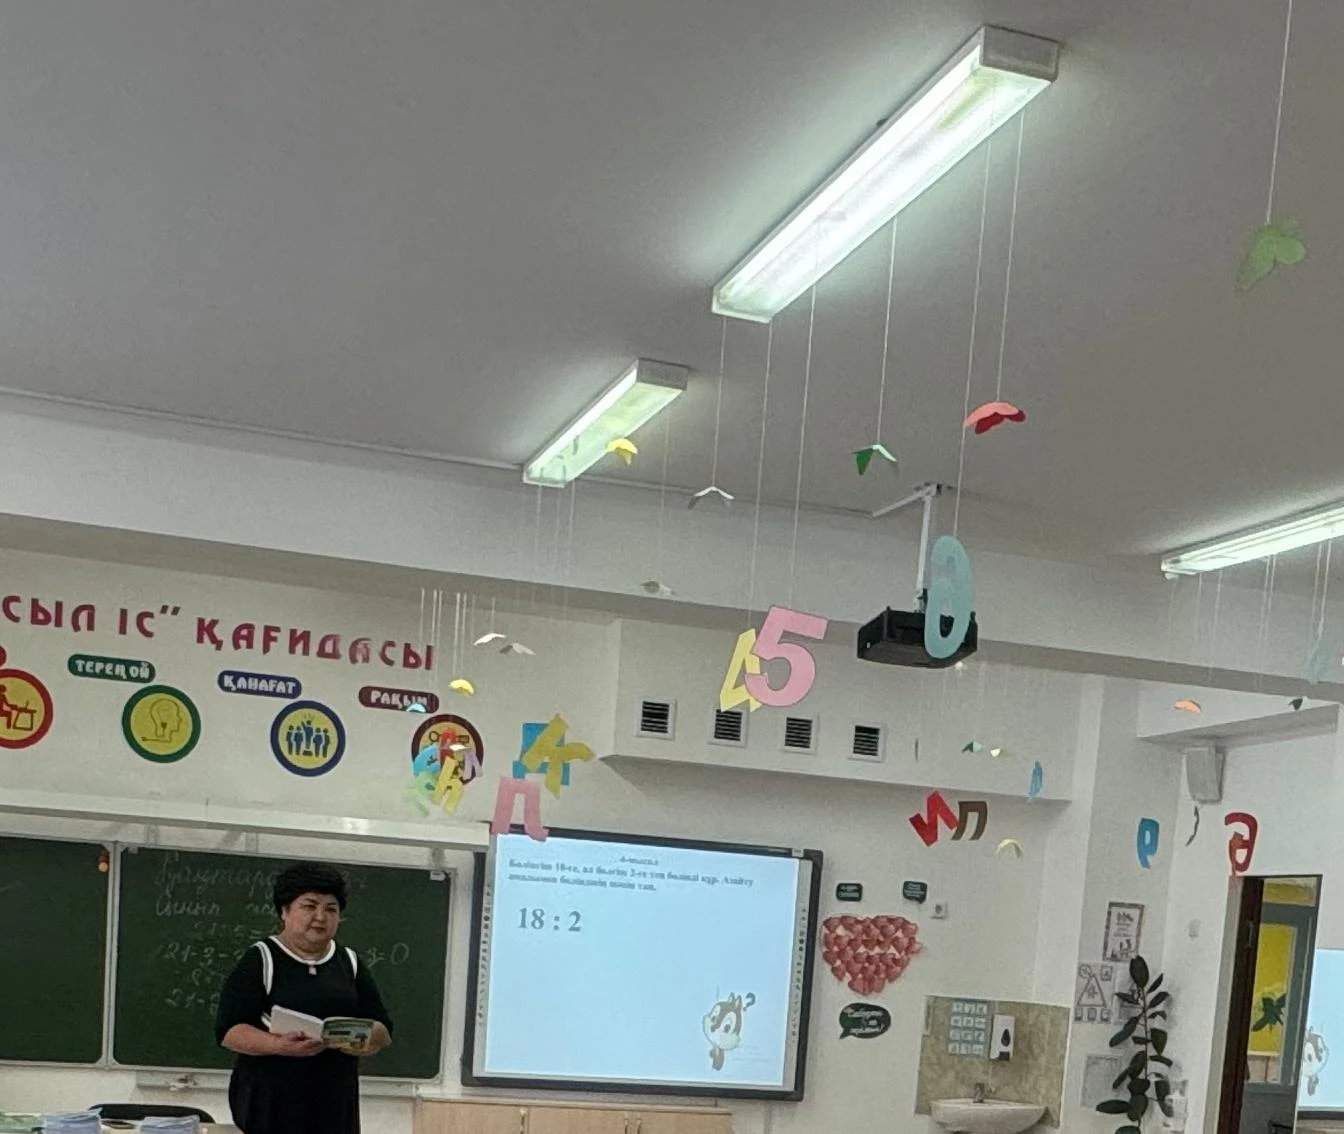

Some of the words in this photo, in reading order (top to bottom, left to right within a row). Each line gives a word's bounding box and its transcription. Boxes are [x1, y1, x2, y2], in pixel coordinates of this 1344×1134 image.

[196, 617, 435, 670] ҚАҒИДАСЫ
[744, 605, 828, 707] 5
[75, 659, 127, 679] ТЕРЕҢ
[129, 662, 150, 679] ОЙ
[223, 674, 296, 694] ҚАНАҒАТ
[517, 906, 545, 930] 18
[568, 910, 582, 933] 2
